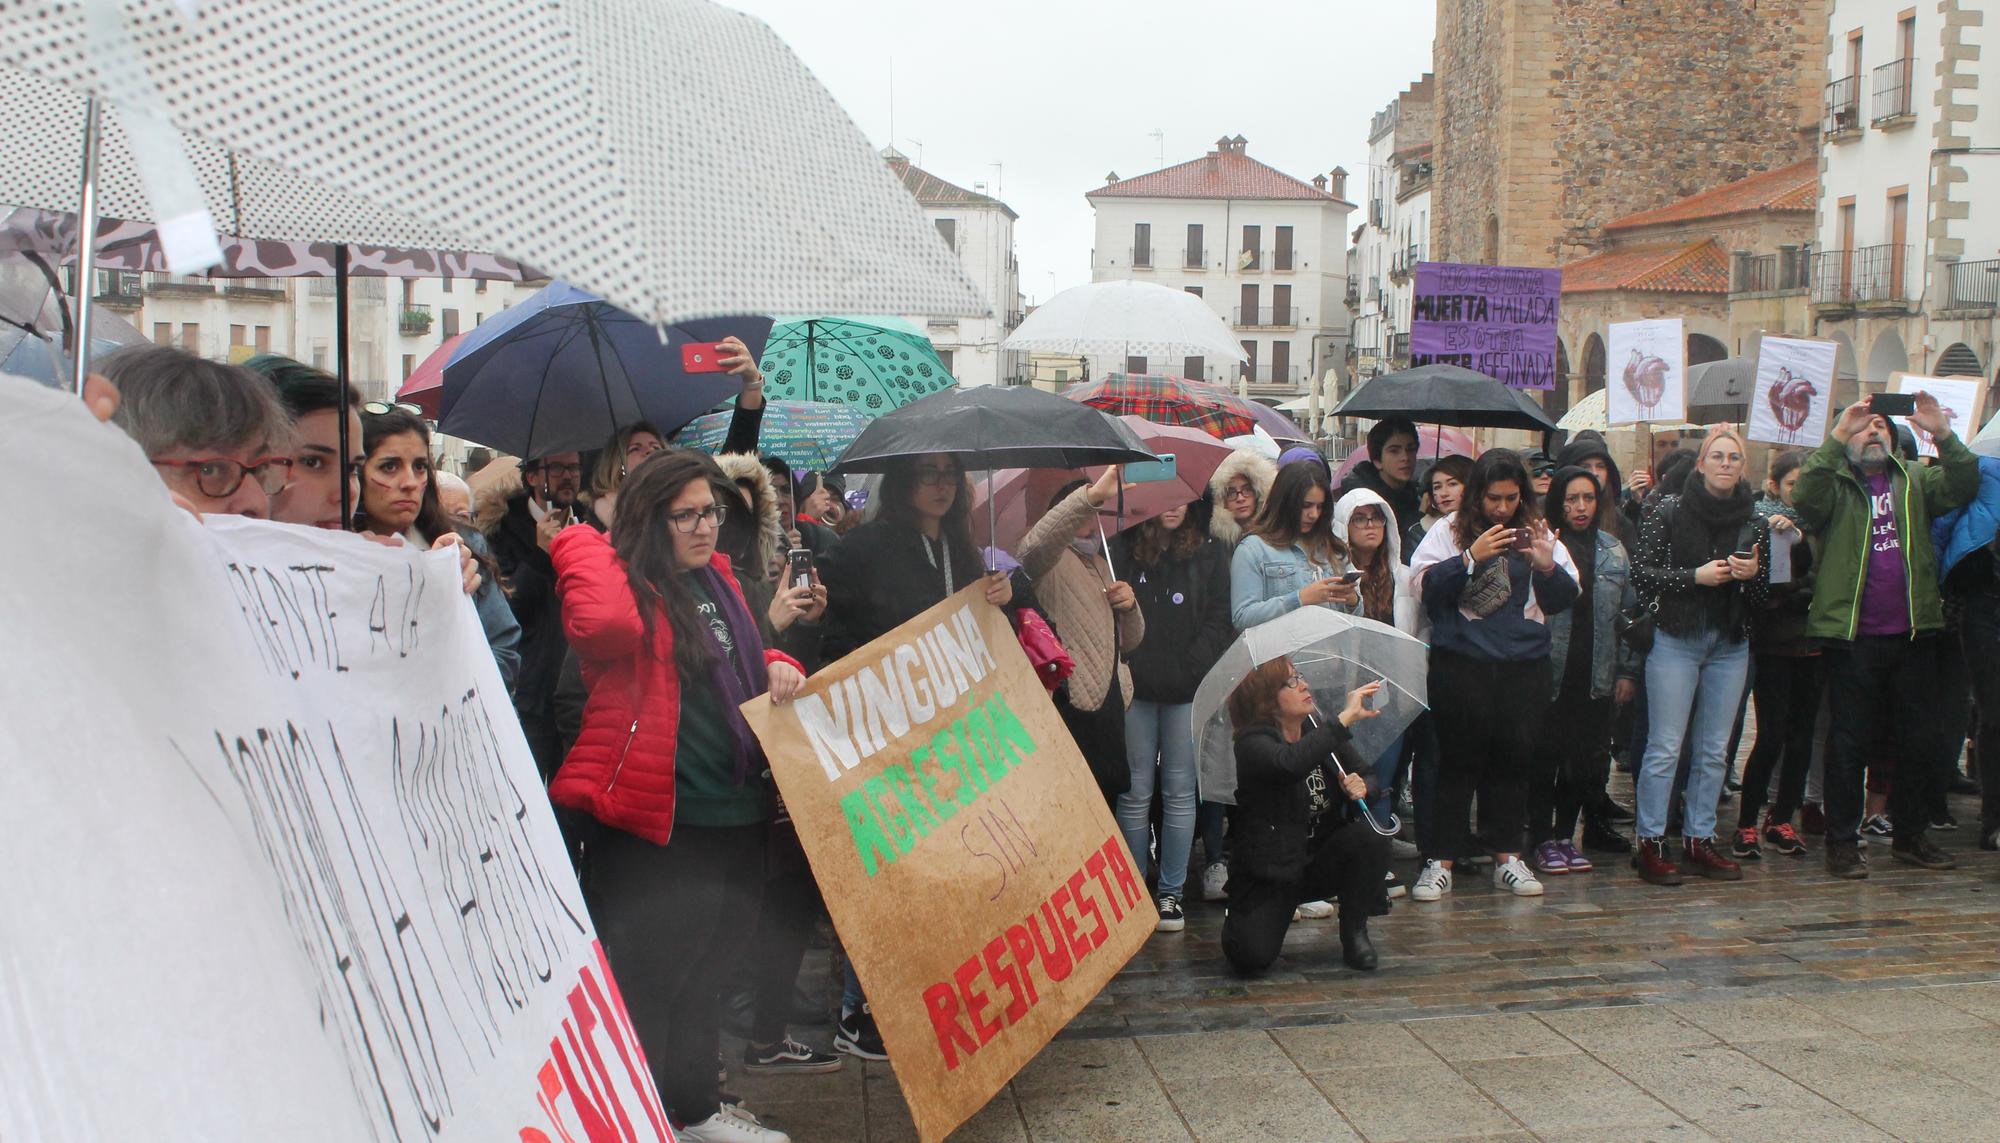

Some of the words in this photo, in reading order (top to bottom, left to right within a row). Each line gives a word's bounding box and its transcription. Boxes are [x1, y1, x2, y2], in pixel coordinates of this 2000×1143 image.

[1414, 295, 1488, 322] MUERTA
[1492, 297, 1554, 324] HALLADA
[1440, 266, 1471, 292] NO
[1475, 268, 1500, 293] ES
[1502, 270, 1545, 295] UNA
[1445, 326, 1470, 350] ES
[1475, 327, 1524, 351] OTRA
[1477, 352, 1554, 385] ASESINADA
[792, 604, 996, 783] NINGUNA
[840, 689, 1037, 877] AGRESIÓN
[961, 798, 1038, 902] SIN
[921, 836, 1142, 1071] RESPUESTA
